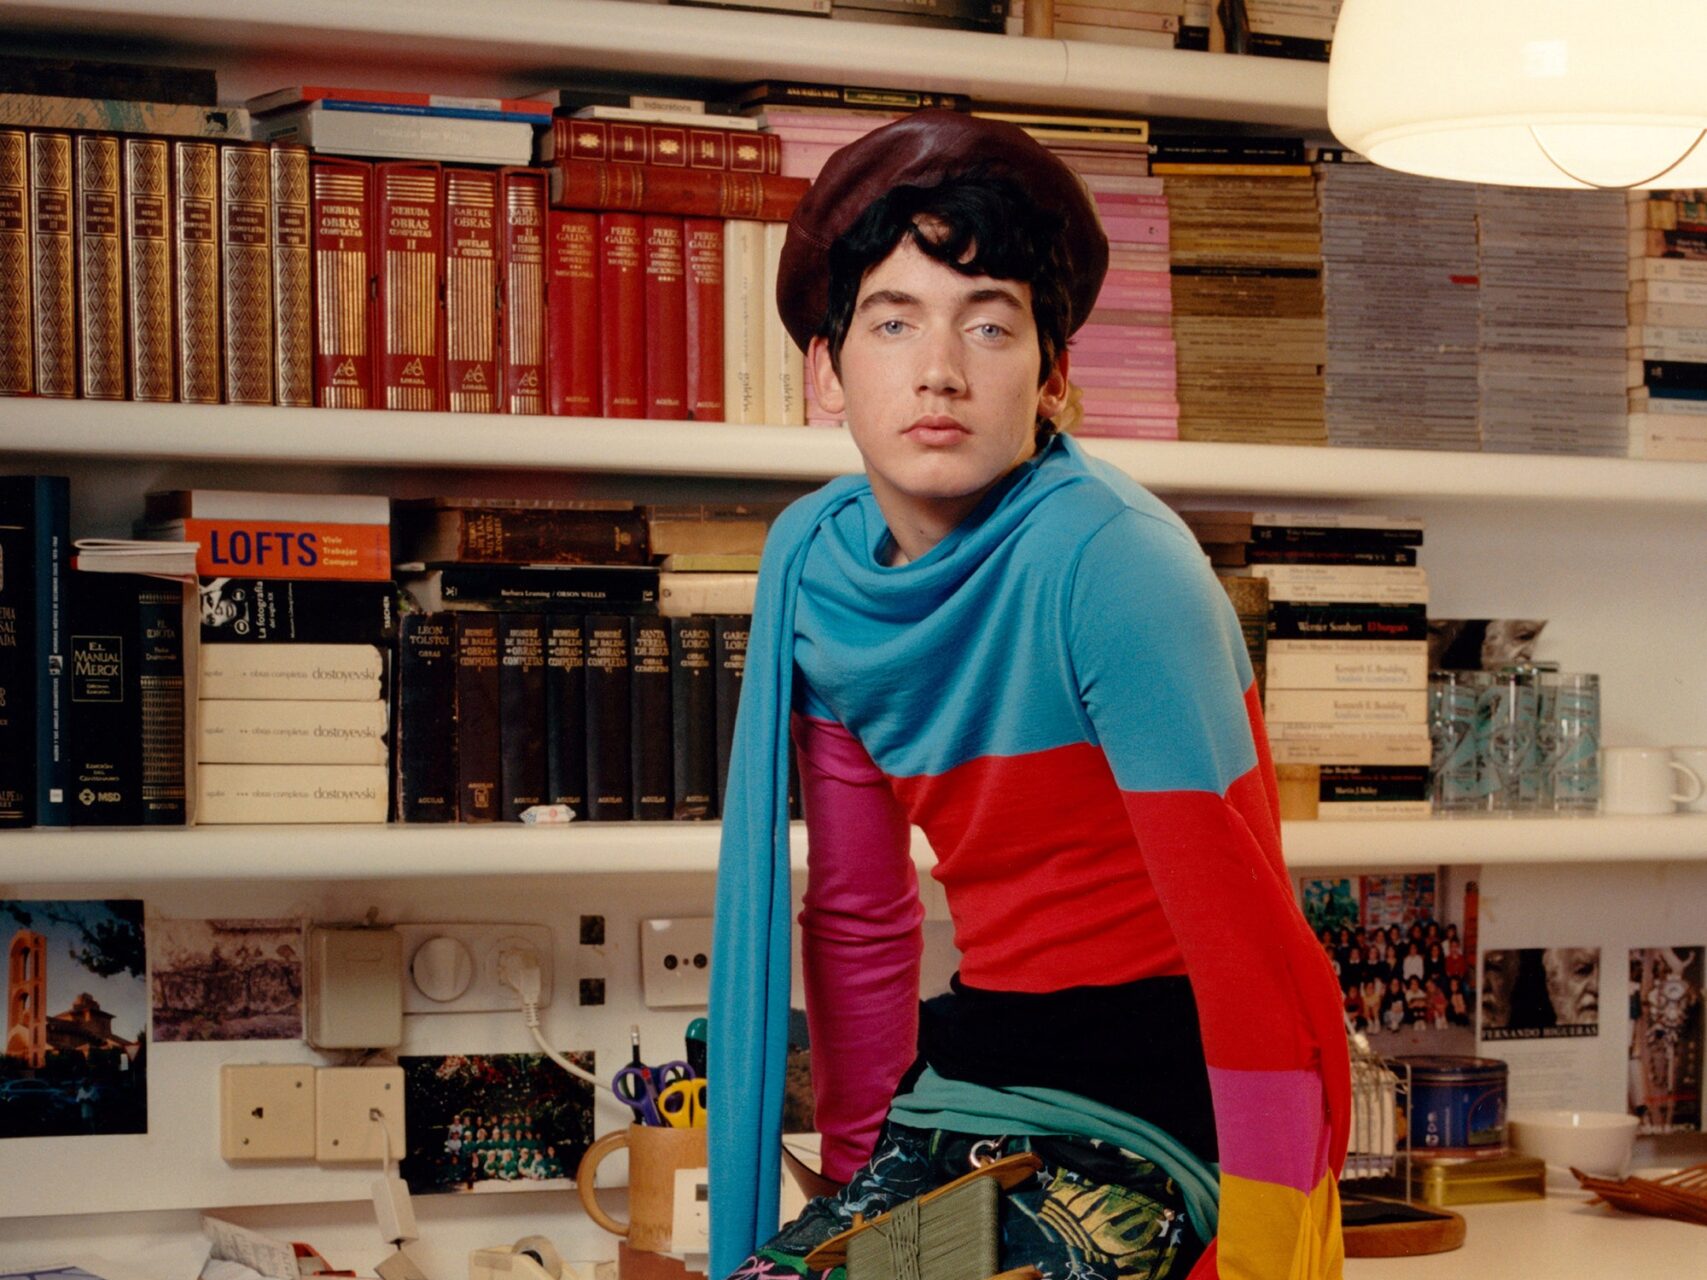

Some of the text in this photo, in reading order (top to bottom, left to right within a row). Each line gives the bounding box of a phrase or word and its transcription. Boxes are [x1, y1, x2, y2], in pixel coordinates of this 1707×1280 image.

[322, 206, 360, 215] NERUDA
[391, 206, 430, 217] NERUDA
[454, 208, 490, 217] SARTRE
[322, 217, 360, 229] OBRAS
[391, 219, 429, 229] OBRAS
[454, 217, 492, 228] OBRAS
[322, 535, 342, 544] Vivir
[211, 530, 318, 567] LOFTS
[322, 547, 358, 556] Trabajar
[322, 558, 359, 567] Comprar
[501, 589, 524, 597] Barbara
[556, 590, 580, 598] ORSON
[254, 581, 266, 639] La fotografía
[1297, 621, 1327, 632] Werner
[409, 635, 449, 645] TOLSTOI
[682, 640, 710, 648] LORCA
[74, 650, 120, 662] MANUAL
[75, 661, 119, 676] MERCK
[312, 667, 375, 683] dostoyevski
[313, 725, 377, 741] dostoyevski
[98, 792, 121, 802] MSD
[313, 787, 377, 803] dostoyevski
[1482, 1025, 1598, 1039] FERNANDO HIGUERAS
